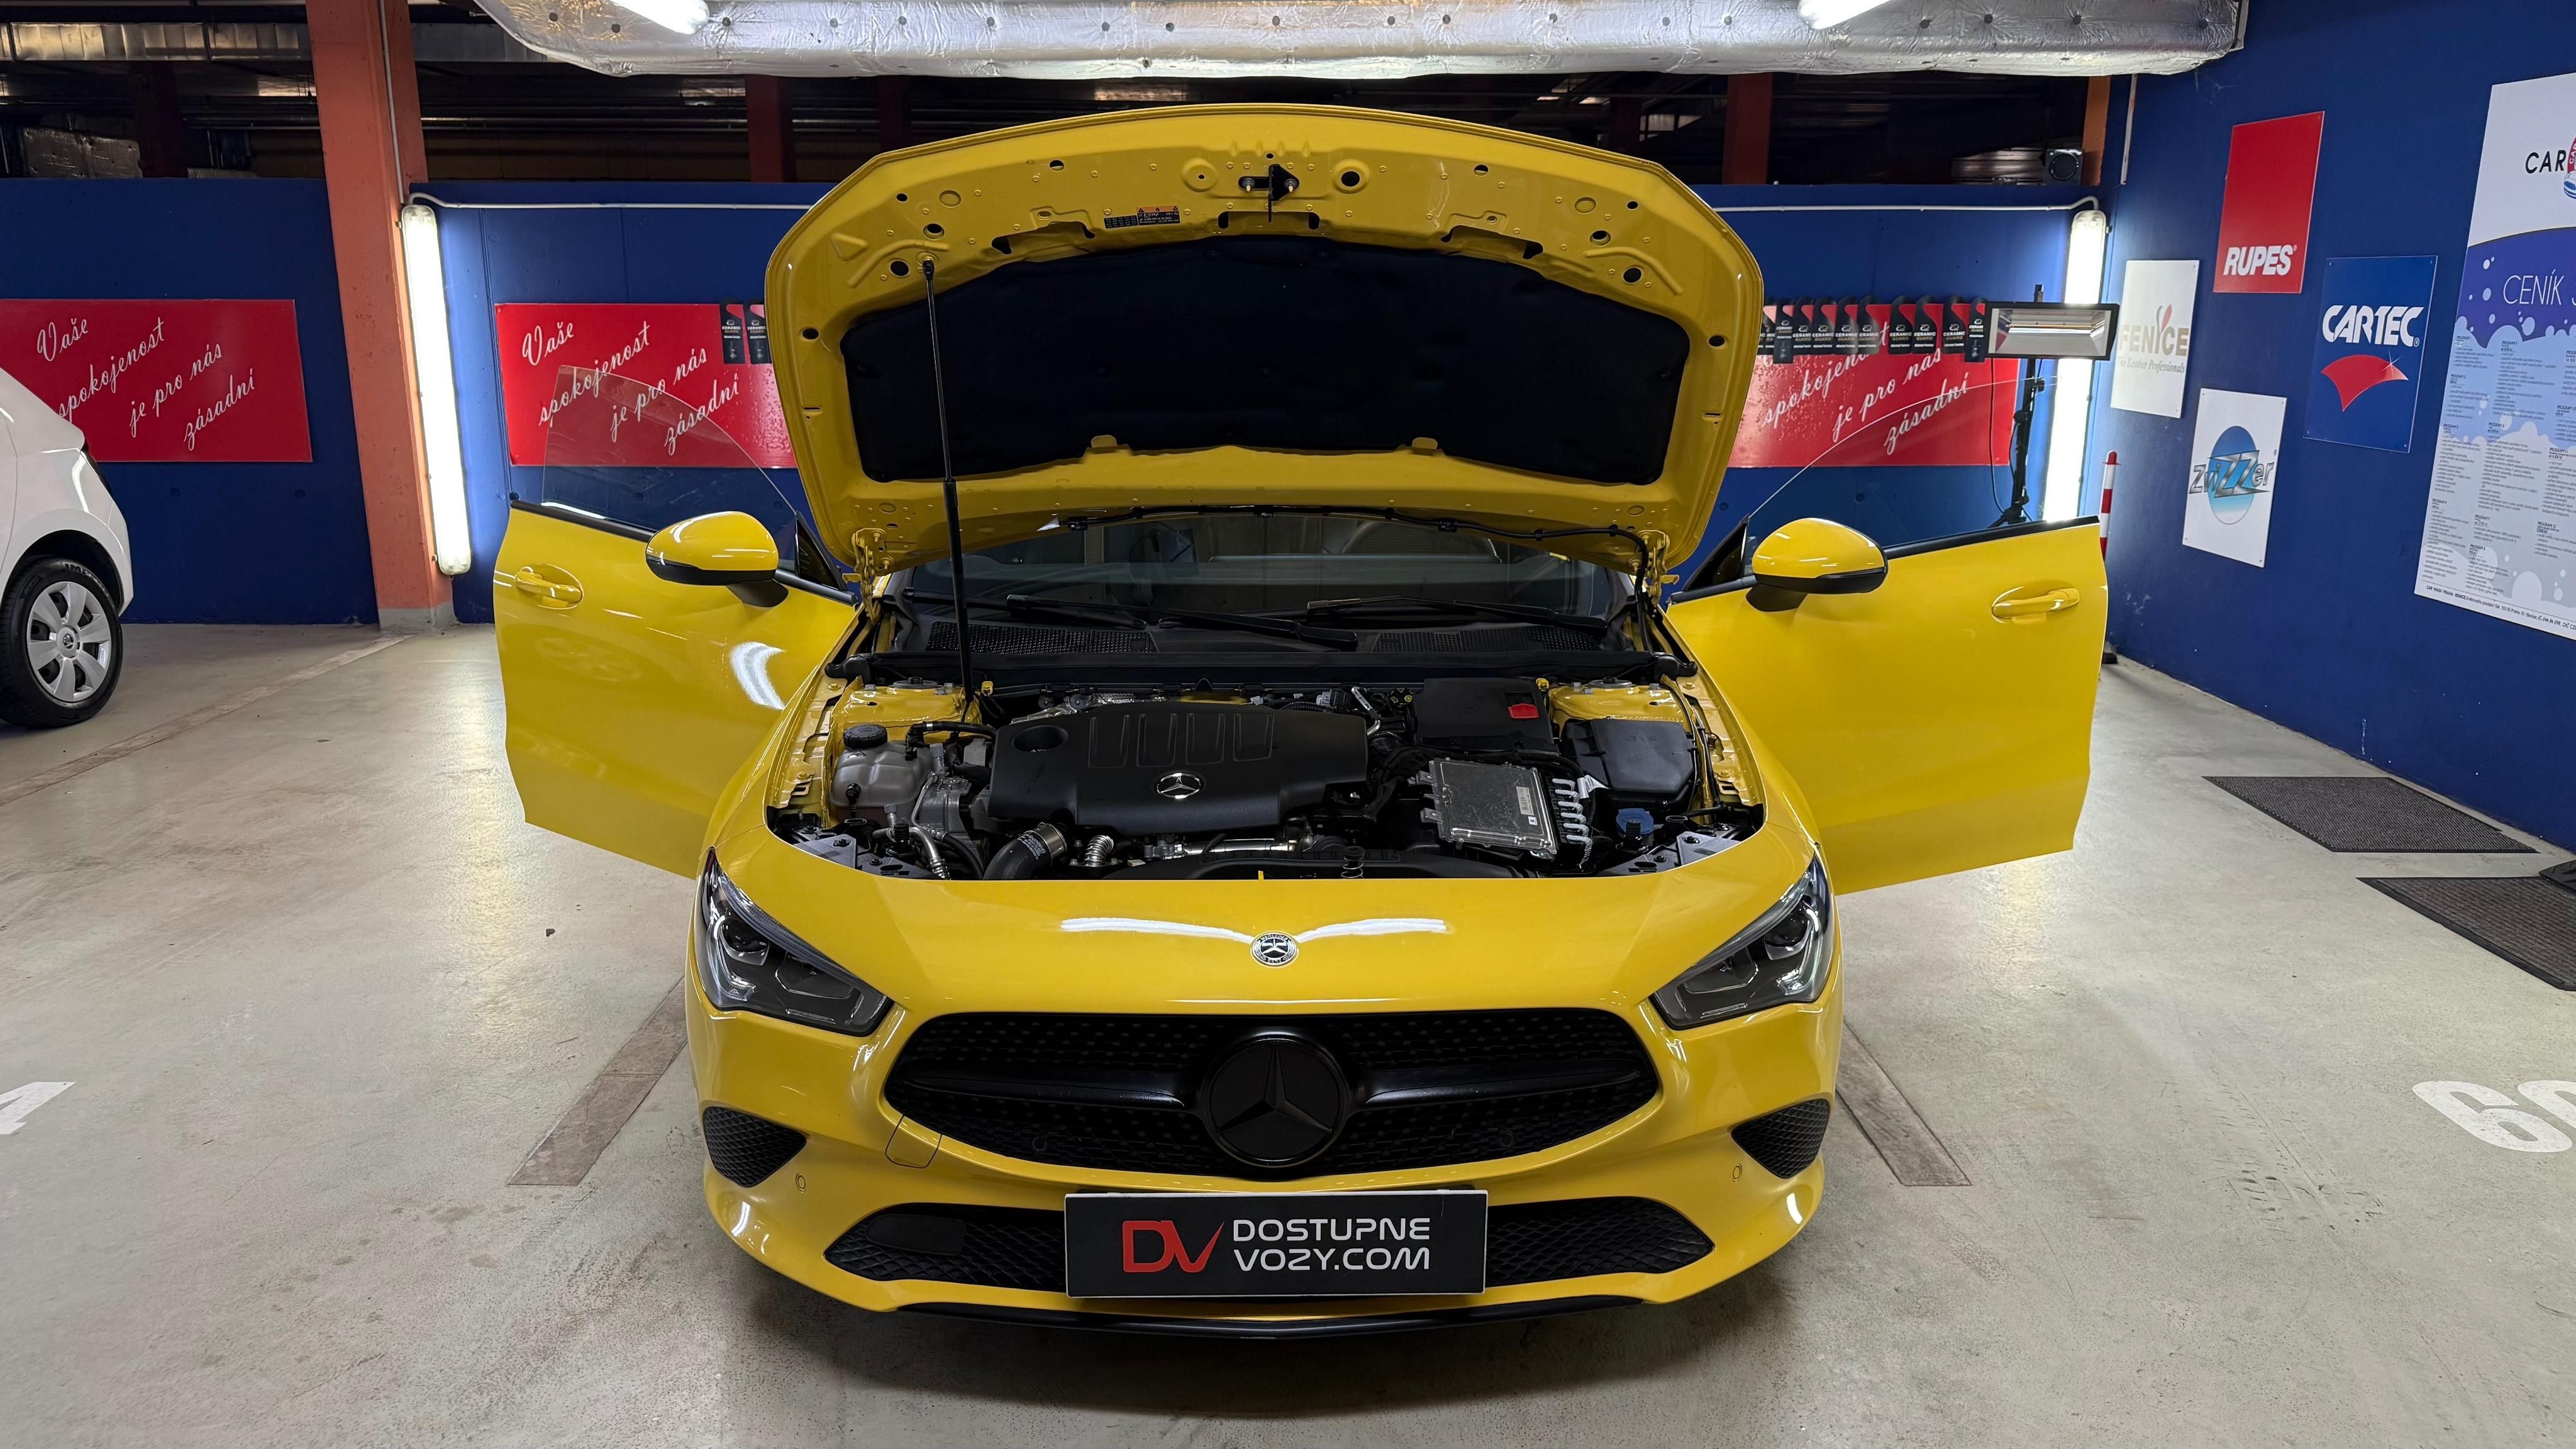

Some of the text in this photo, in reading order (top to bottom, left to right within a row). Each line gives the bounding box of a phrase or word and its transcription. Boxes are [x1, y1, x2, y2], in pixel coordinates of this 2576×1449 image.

[2525, 150, 2567, 174] CAR
[2223, 245, 2294, 275] RUPES
[2503, 269, 2565, 305] CENÍK
[37, 318, 88, 362] Vaše
[522, 321, 574, 365] Vaše
[2119, 325, 2189, 356] FENICE
[2322, 305, 2424, 347] CARTEC
[59, 316, 165, 424] spokojenost
[538, 321, 650, 428] spokojenost
[2148, 360, 2185, 374] Professionals
[130, 344, 222, 438] je pro nás
[184, 368, 255, 450] zásadní
[611, 348, 708, 443] je pro nás
[1832, 405, 1853, 443] je
[1859, 379, 1896, 422] pro
[664, 373, 739, 456] zásadní
[1884, 372, 1969, 455] zásadní
[1233, 1218, 1430, 1243] DOSTUPNE
[1234, 1248, 1430, 1272] VOZY.COM
